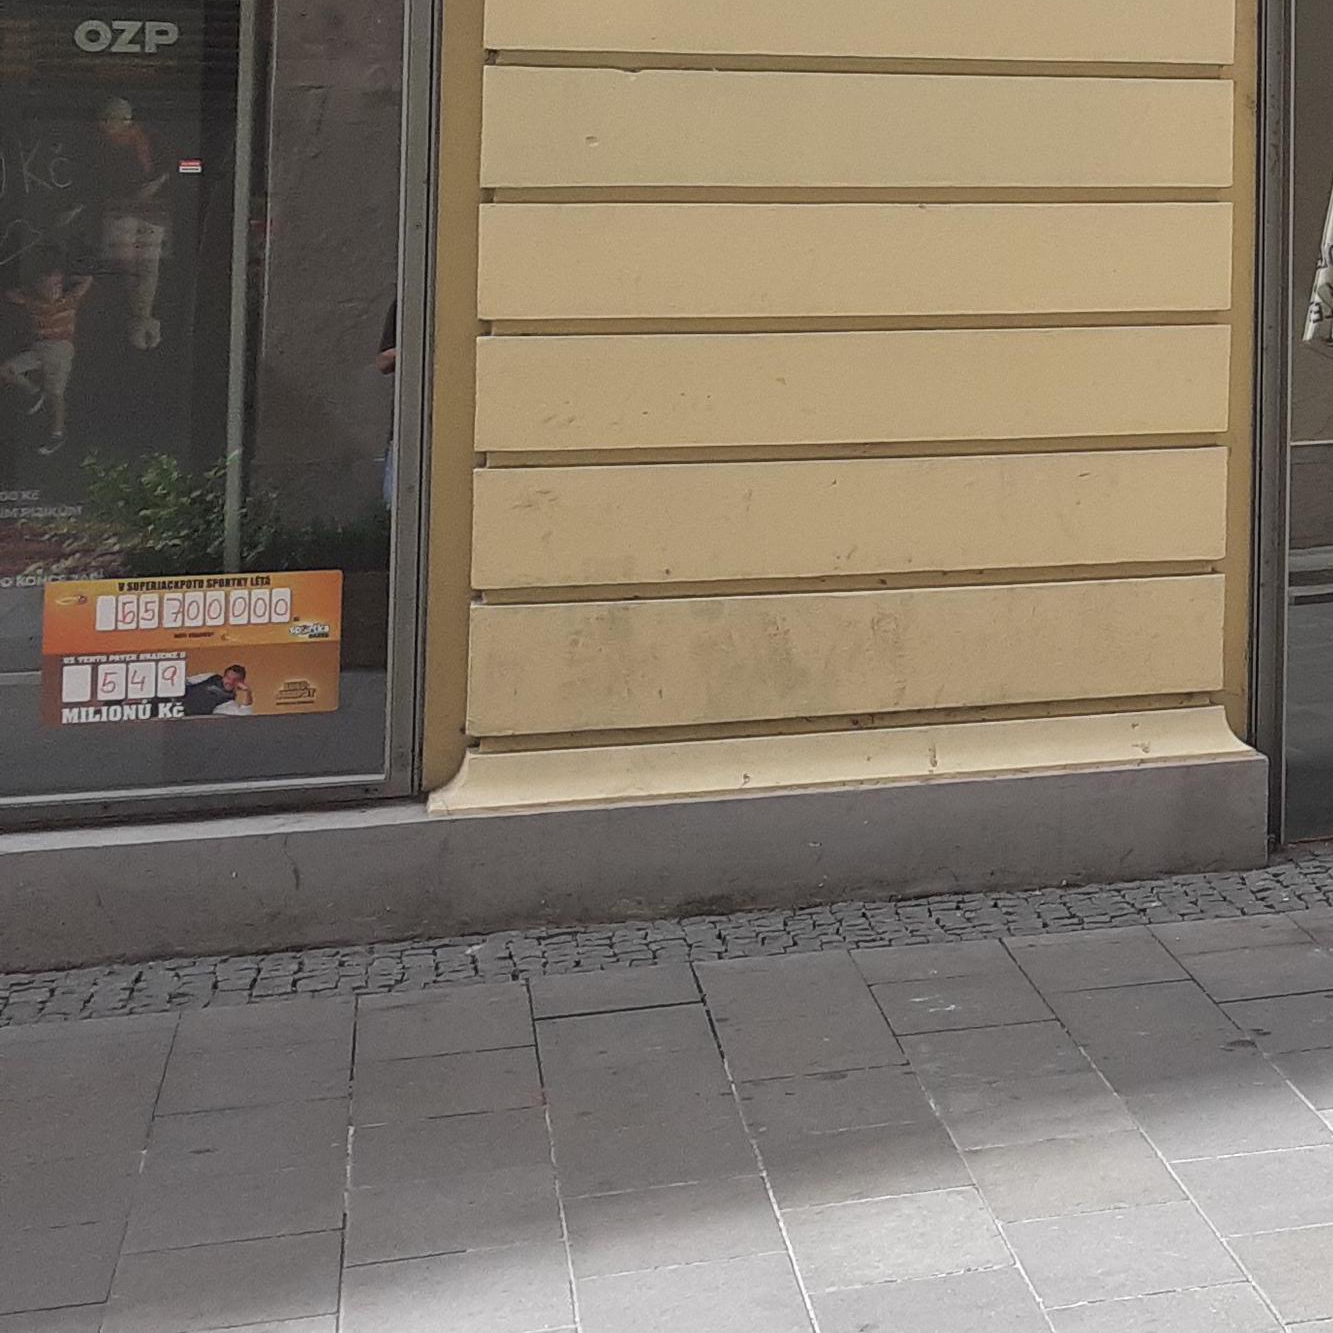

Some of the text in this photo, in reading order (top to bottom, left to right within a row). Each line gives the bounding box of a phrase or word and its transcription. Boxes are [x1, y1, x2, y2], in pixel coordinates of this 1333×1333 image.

[73, 19, 180, 53] OZP
[62, 699, 186, 724] MILIONŮ Kč
